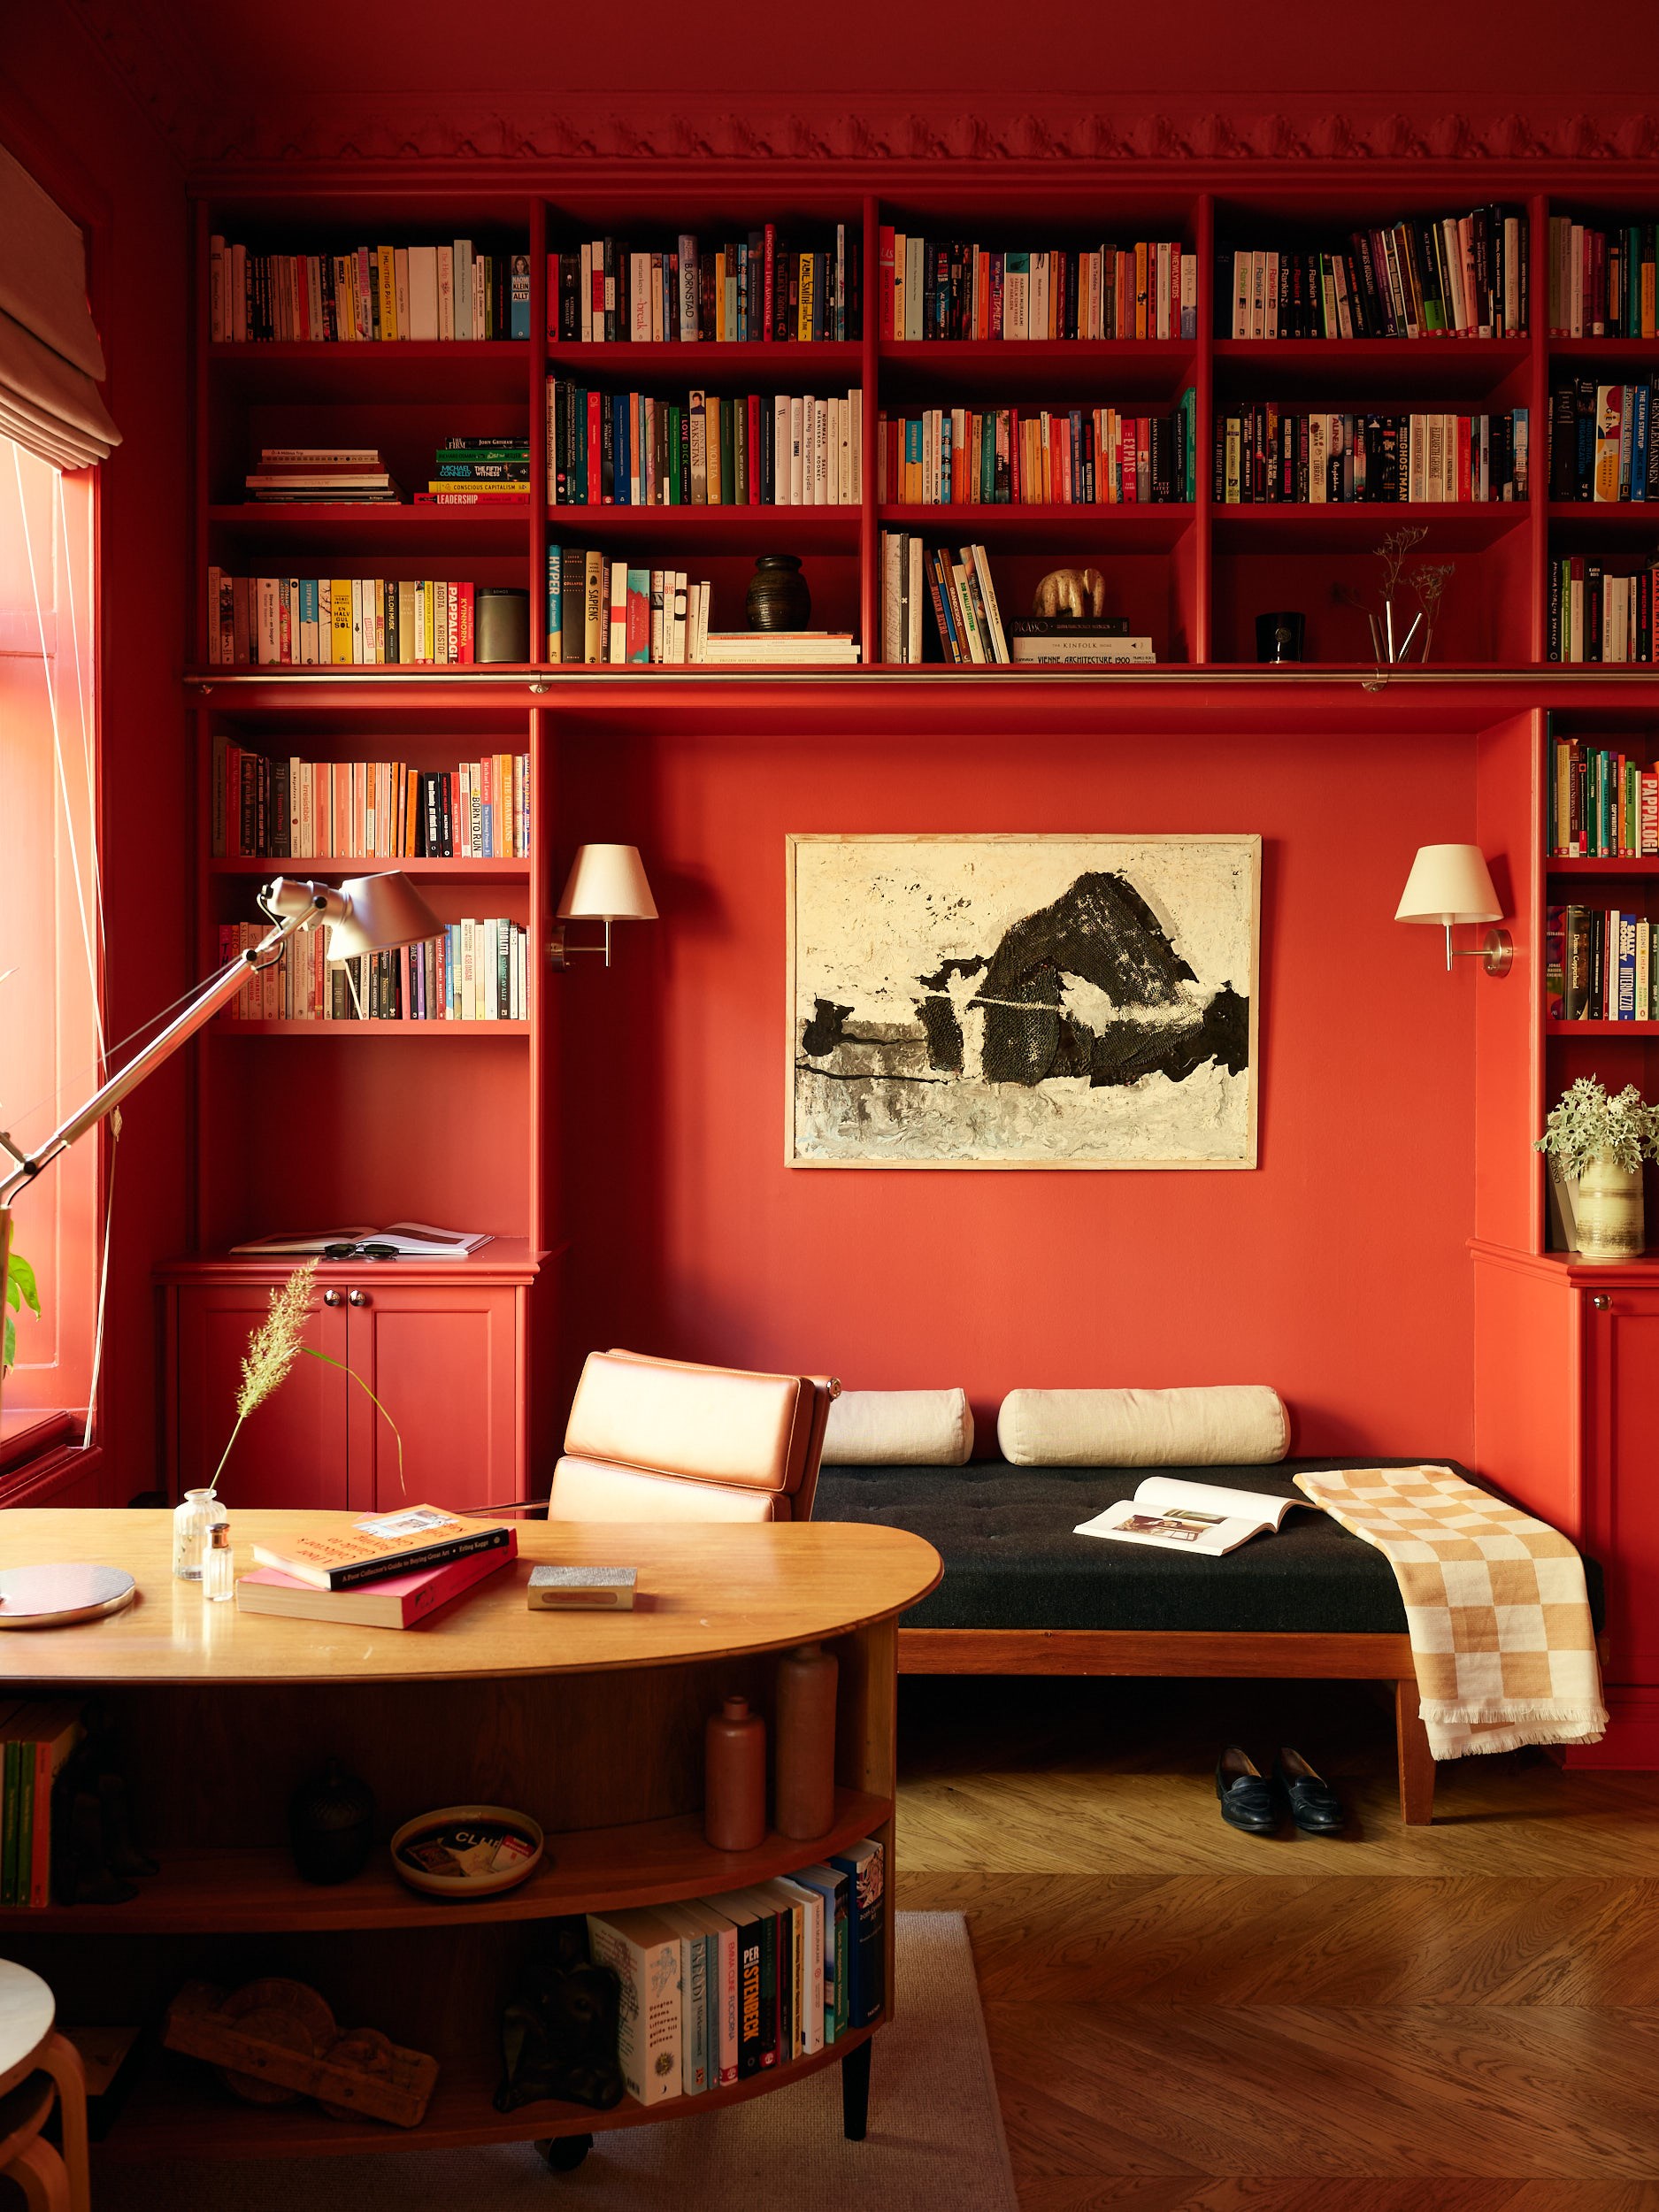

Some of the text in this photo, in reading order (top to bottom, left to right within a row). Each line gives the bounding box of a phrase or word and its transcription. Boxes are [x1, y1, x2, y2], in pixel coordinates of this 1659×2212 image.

[685, 263, 694, 318] BJÖRNSTAD
[802, 283, 810, 303] SMITH
[637, 301, 647, 330] break
[1123, 439, 1135, 472] EXPATS
[1431, 427, 1440, 479] ELIZABETH GEORGE
[1649, 398, 1659, 483] GENTLEMANNEN
[437, 495, 478, 504] LEADERSHIP
[549, 557, 560, 595] HYPER
[588, 590, 598, 621] SAPIENS
[931, 586, 948, 634] MODERN RETRO
[449, 588, 457, 658] PAPPALOGI
[472, 821, 480, 831] TO
[1642, 780, 1658, 853] PAPPALOGI
[473, 834, 482, 851] RUN
[1619, 967, 1633, 1010] INTERMEZZO
[743, 1945, 759, 1962] PER
[650, 2001, 672, 2011] Douglas
[650, 2010, 669, 2020] Adams
[743, 1965, 759, 2043] STENBECK
[650, 2016, 677, 2029] Liftarens
[650, 2029, 665, 2039] guide
[650, 2035, 672, 2047] galaxen
